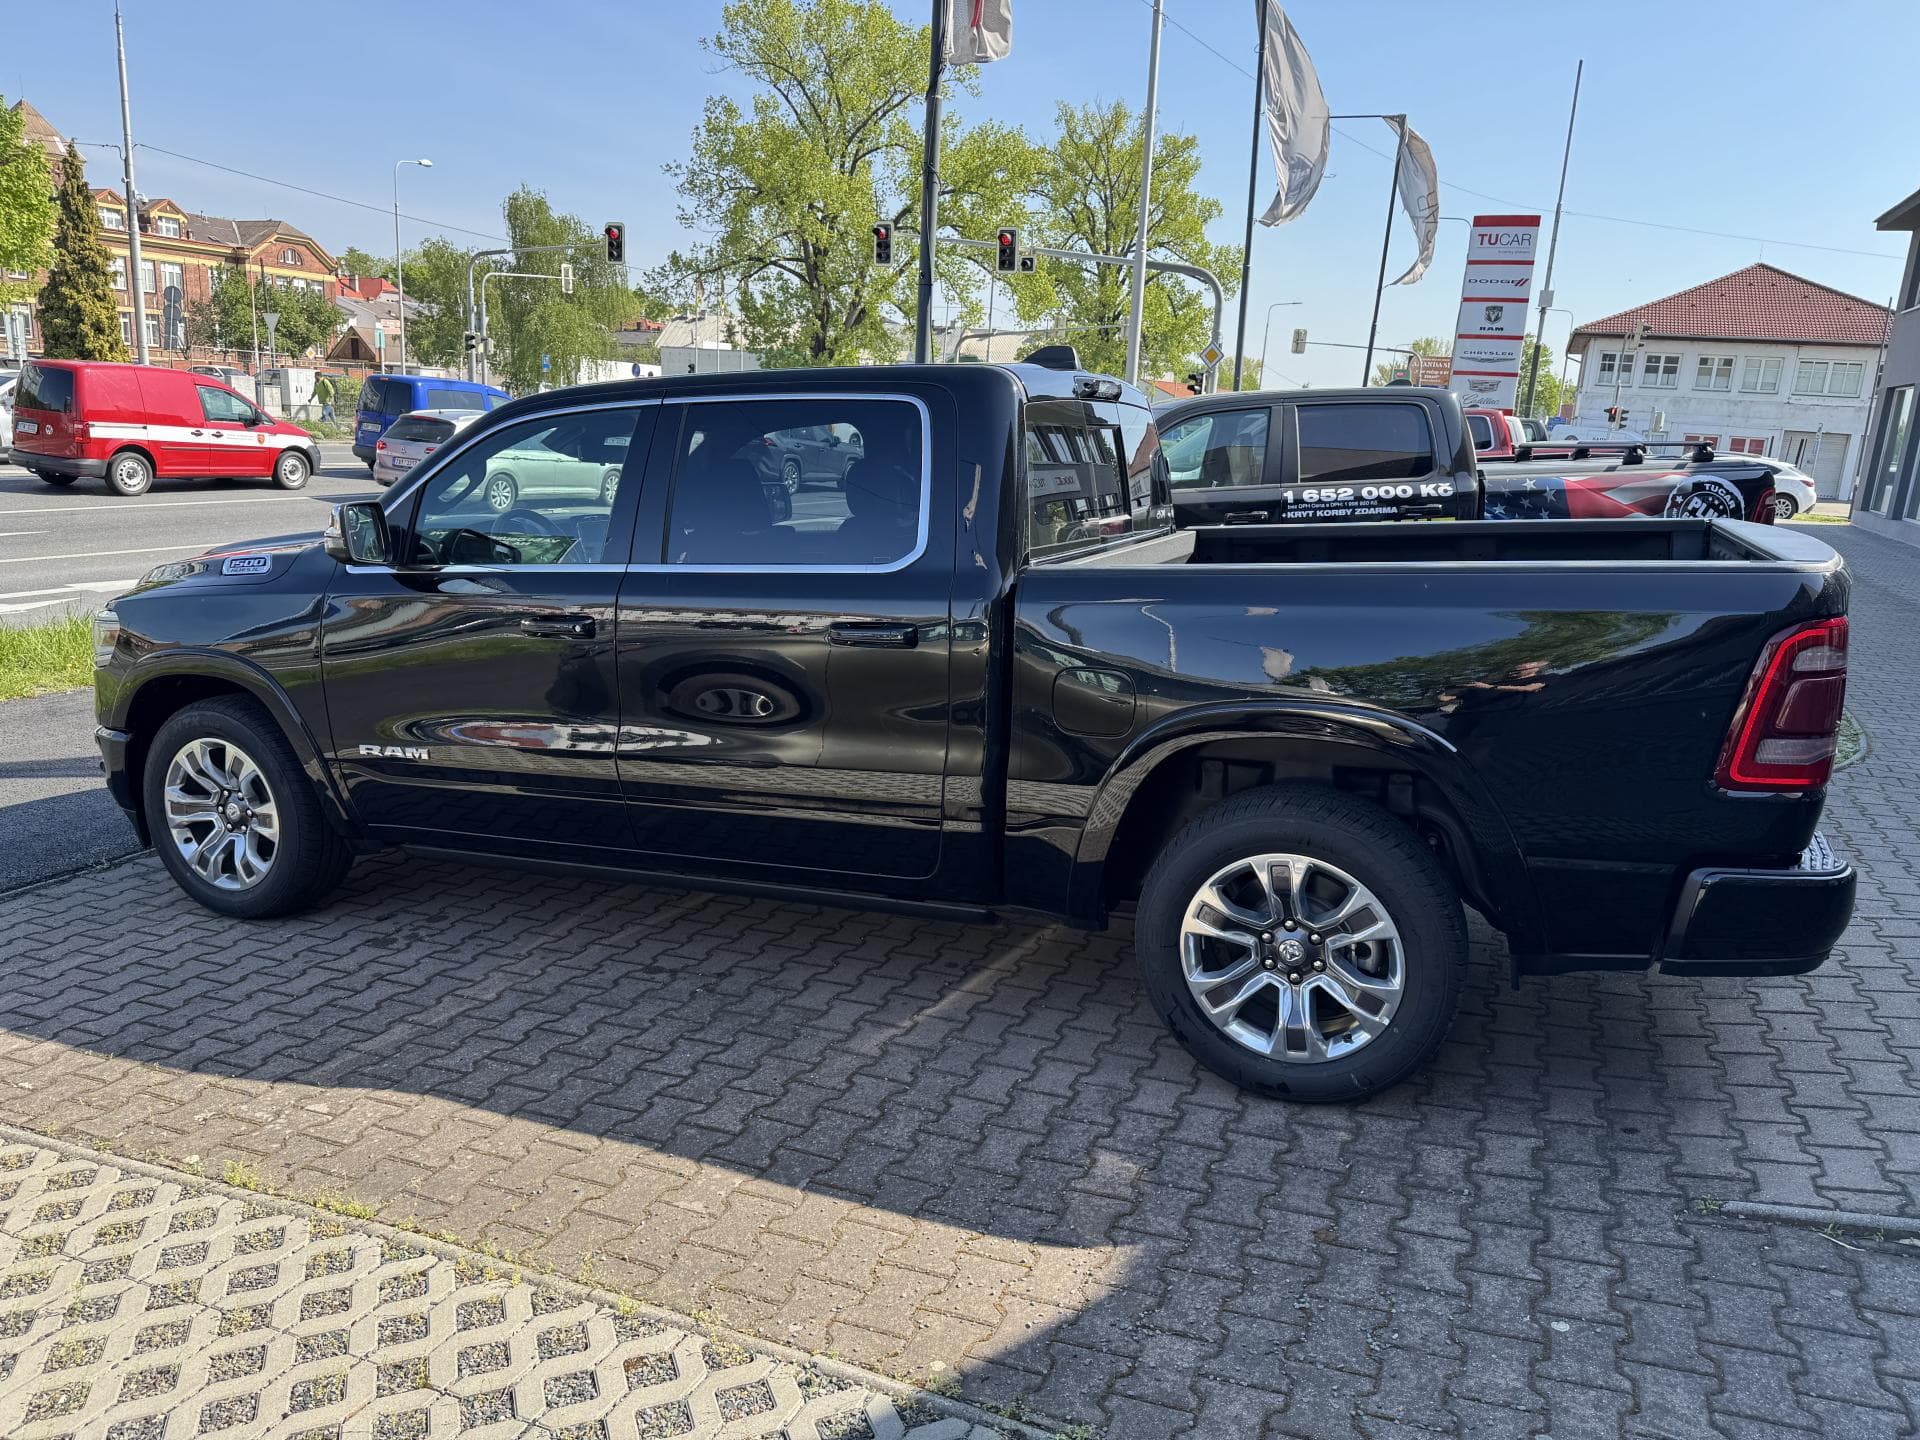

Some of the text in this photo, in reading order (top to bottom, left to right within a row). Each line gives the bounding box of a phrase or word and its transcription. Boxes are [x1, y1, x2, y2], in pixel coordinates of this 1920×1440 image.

[1477, 232, 1532, 246] TUCAR
[1284, 483, 1453, 503] 1 652 000 Kč
[1703, 483, 1736, 509] TUCAR
[1317, 509, 1352, 517] KORBY
[1355, 506, 1398, 515] ZDARMA
[1687, 496, 1719, 519] PLU
[231, 559, 266, 567] 1500
[359, 744, 429, 760] RAM
